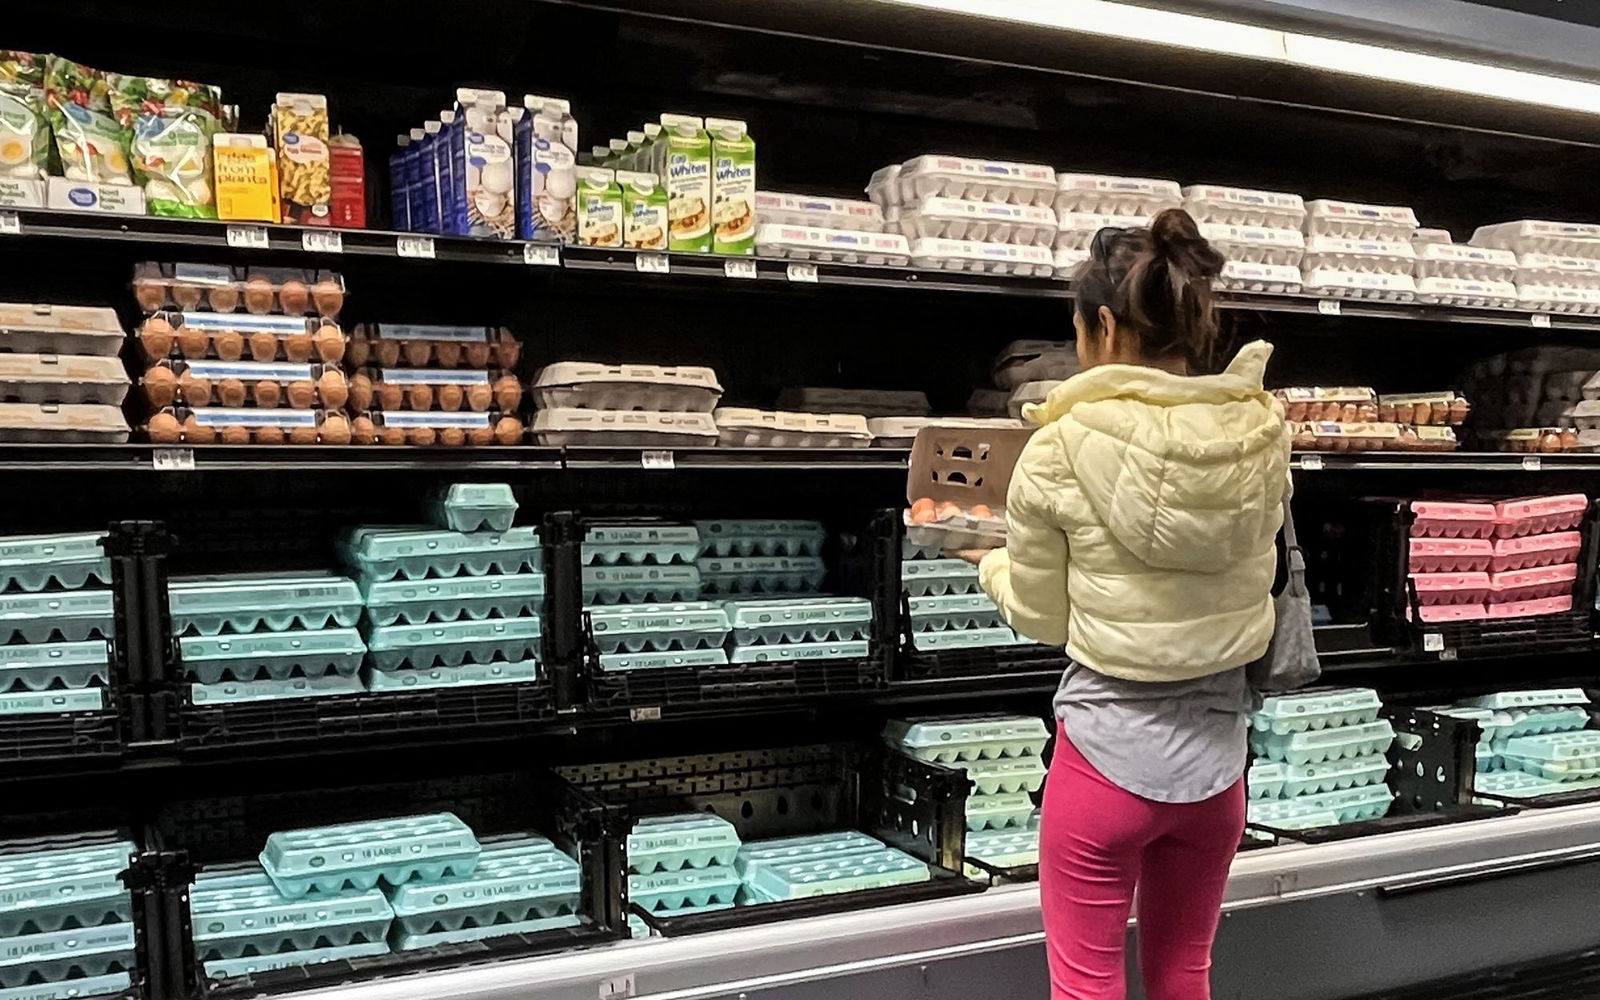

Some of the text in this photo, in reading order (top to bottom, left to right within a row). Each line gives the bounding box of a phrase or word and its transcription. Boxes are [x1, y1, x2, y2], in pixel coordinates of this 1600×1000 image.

[670, 164, 707, 177] Whites
[716, 168, 751, 181] Whites
[362, 846, 401, 858] 18 LARGE
[265, 916, 275, 925] 18
[7, 942, 55, 956] 18 LARGE
